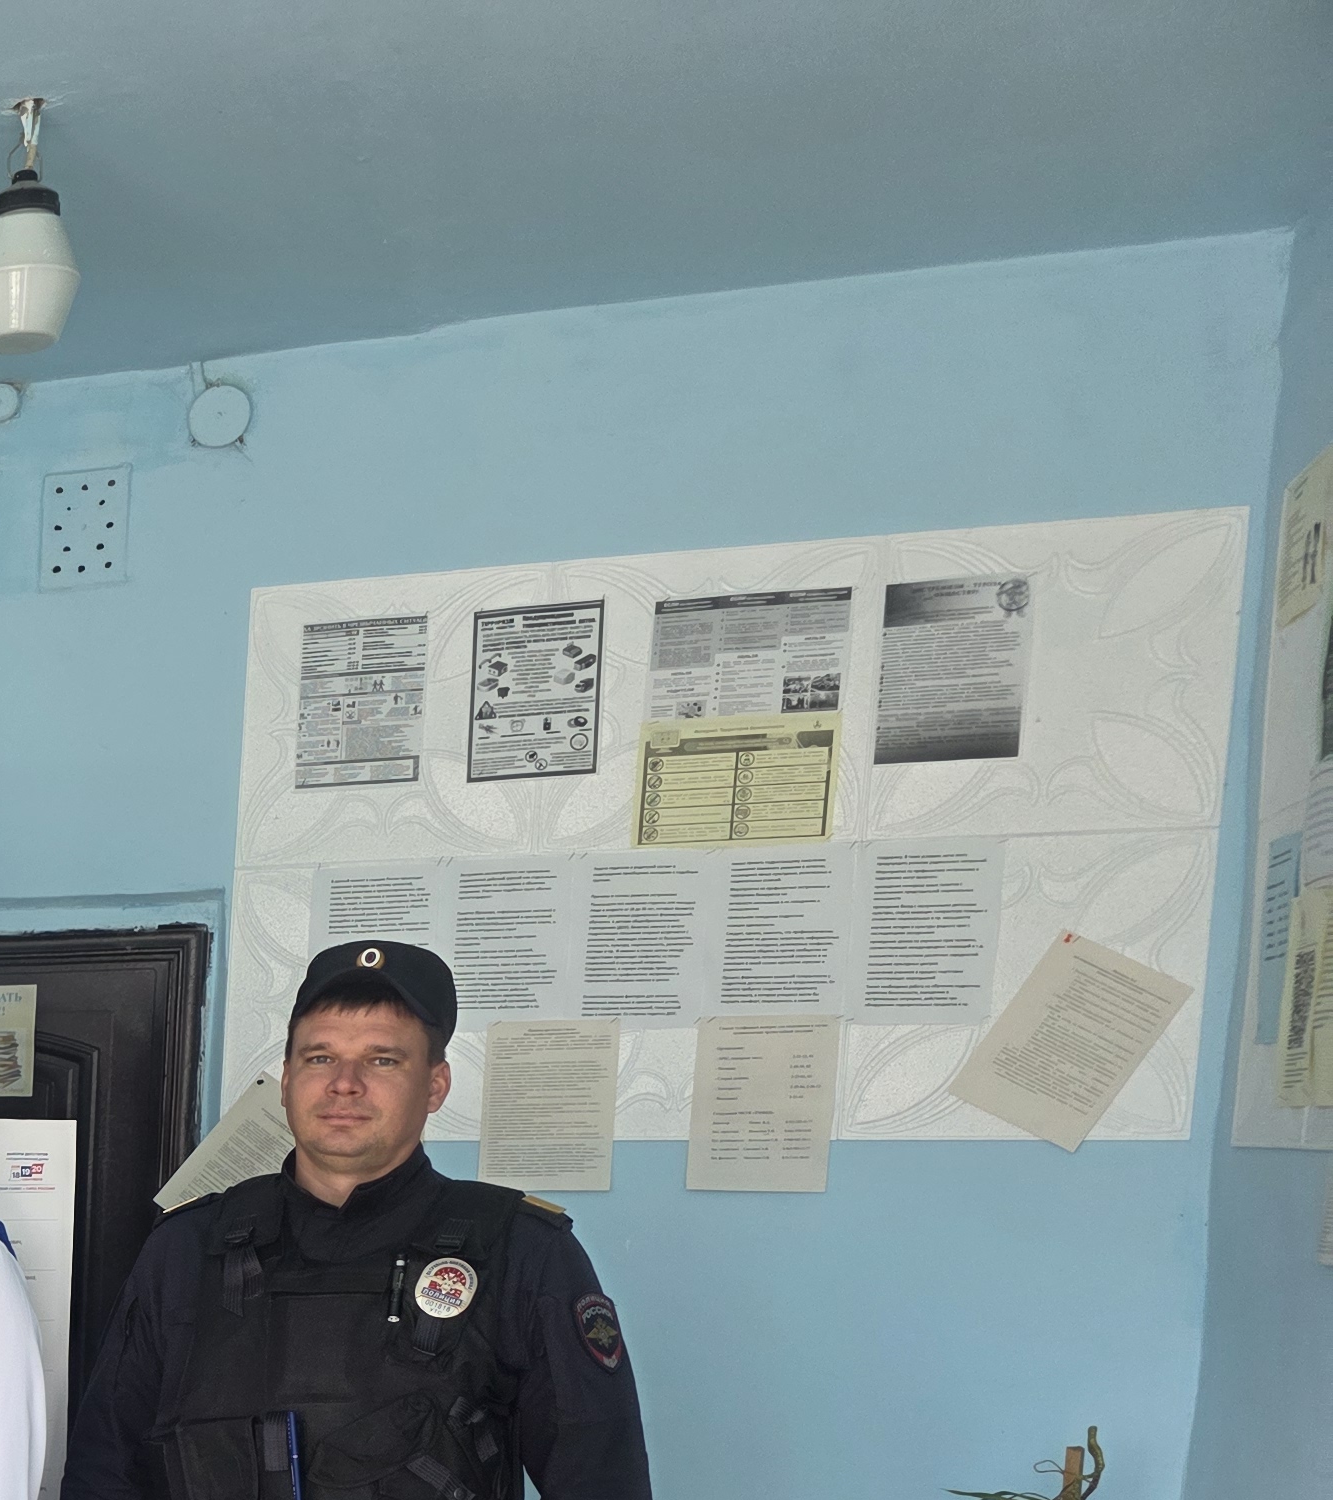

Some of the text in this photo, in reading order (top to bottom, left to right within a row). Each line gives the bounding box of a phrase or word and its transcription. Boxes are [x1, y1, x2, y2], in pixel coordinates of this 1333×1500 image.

[21, 1167, 30, 1176] 19
[31, 1165, 42, 1173] 20
[422, 1288, 462, 1306] ПОЛИЦИЯ
